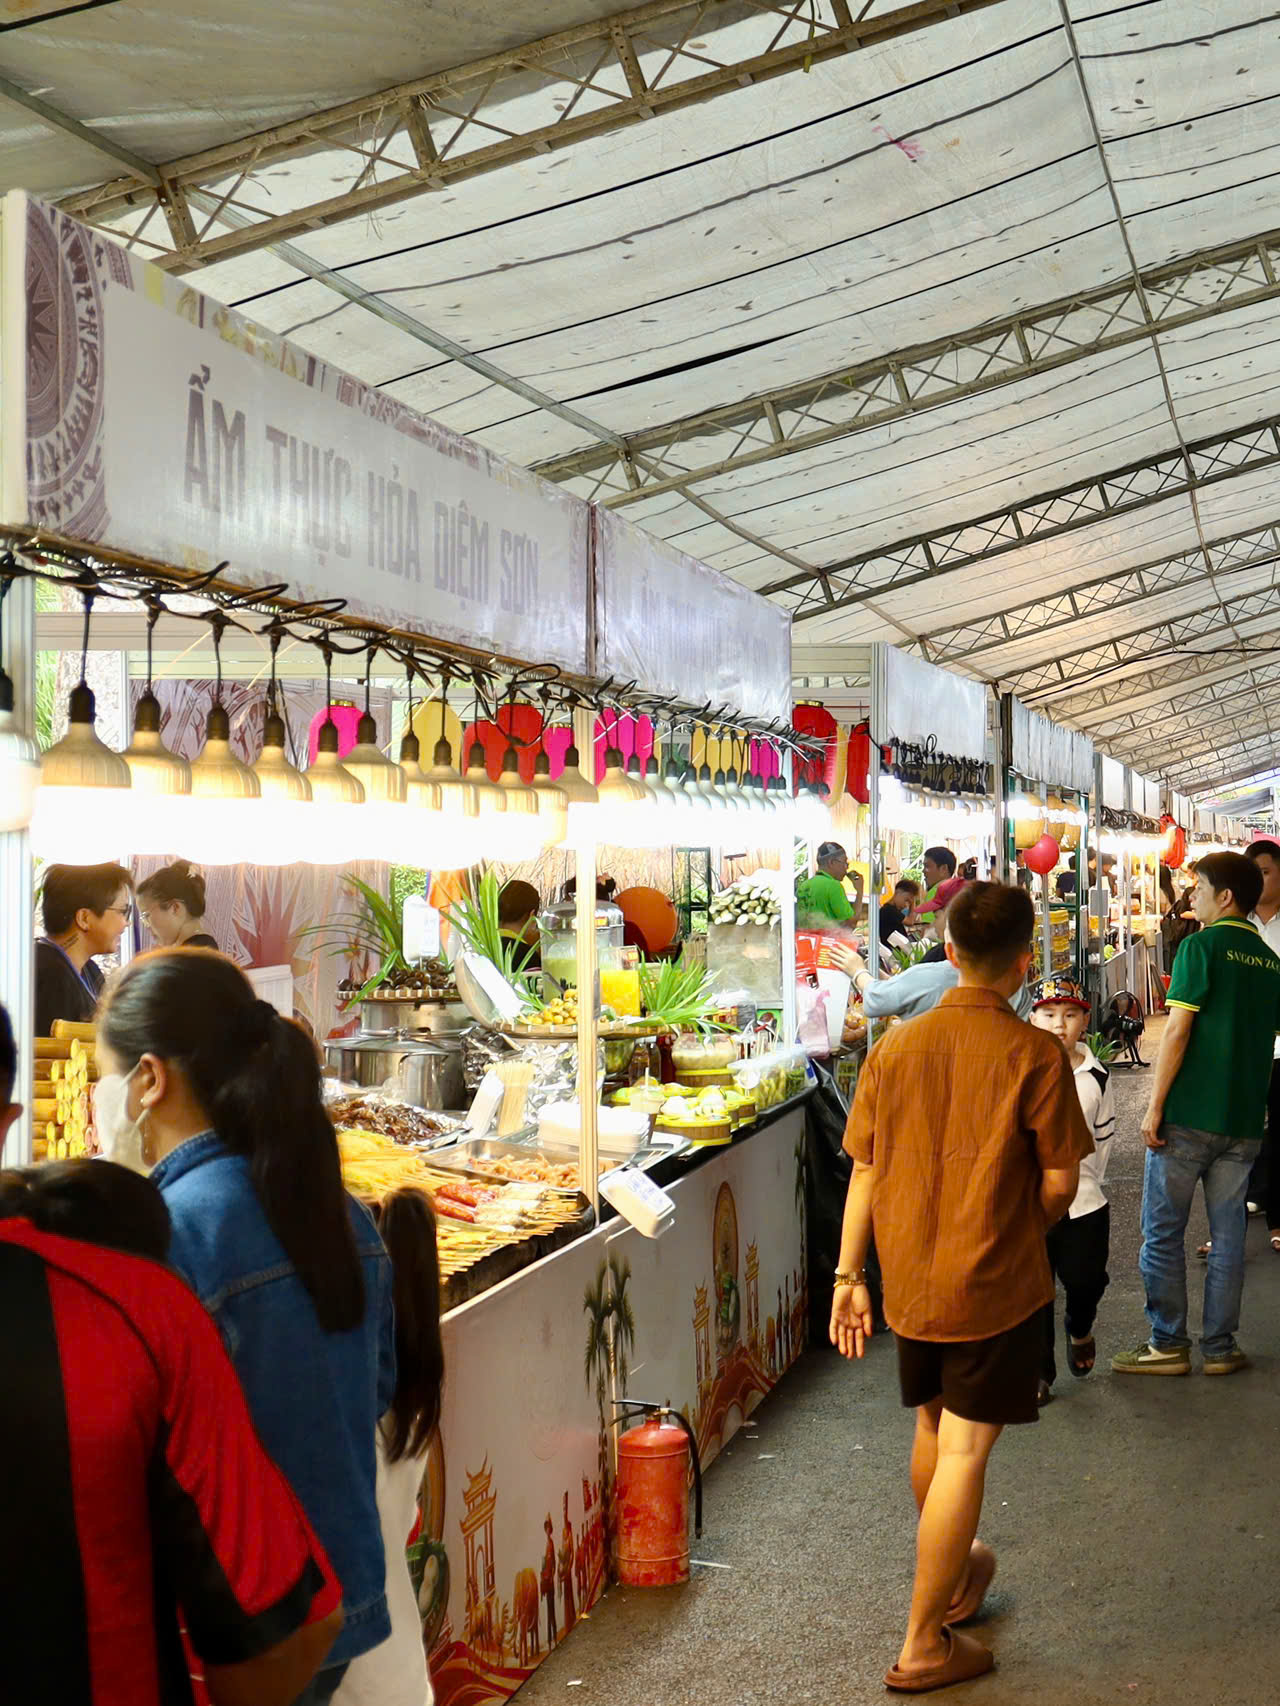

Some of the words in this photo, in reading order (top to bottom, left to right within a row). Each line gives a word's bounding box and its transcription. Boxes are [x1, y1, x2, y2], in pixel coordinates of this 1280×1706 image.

[184, 363, 246, 523] ẨM
[265, 424, 352, 567] THỰC
[434, 499, 489, 612] DIỆM
[500, 526, 539, 617] SƠN
